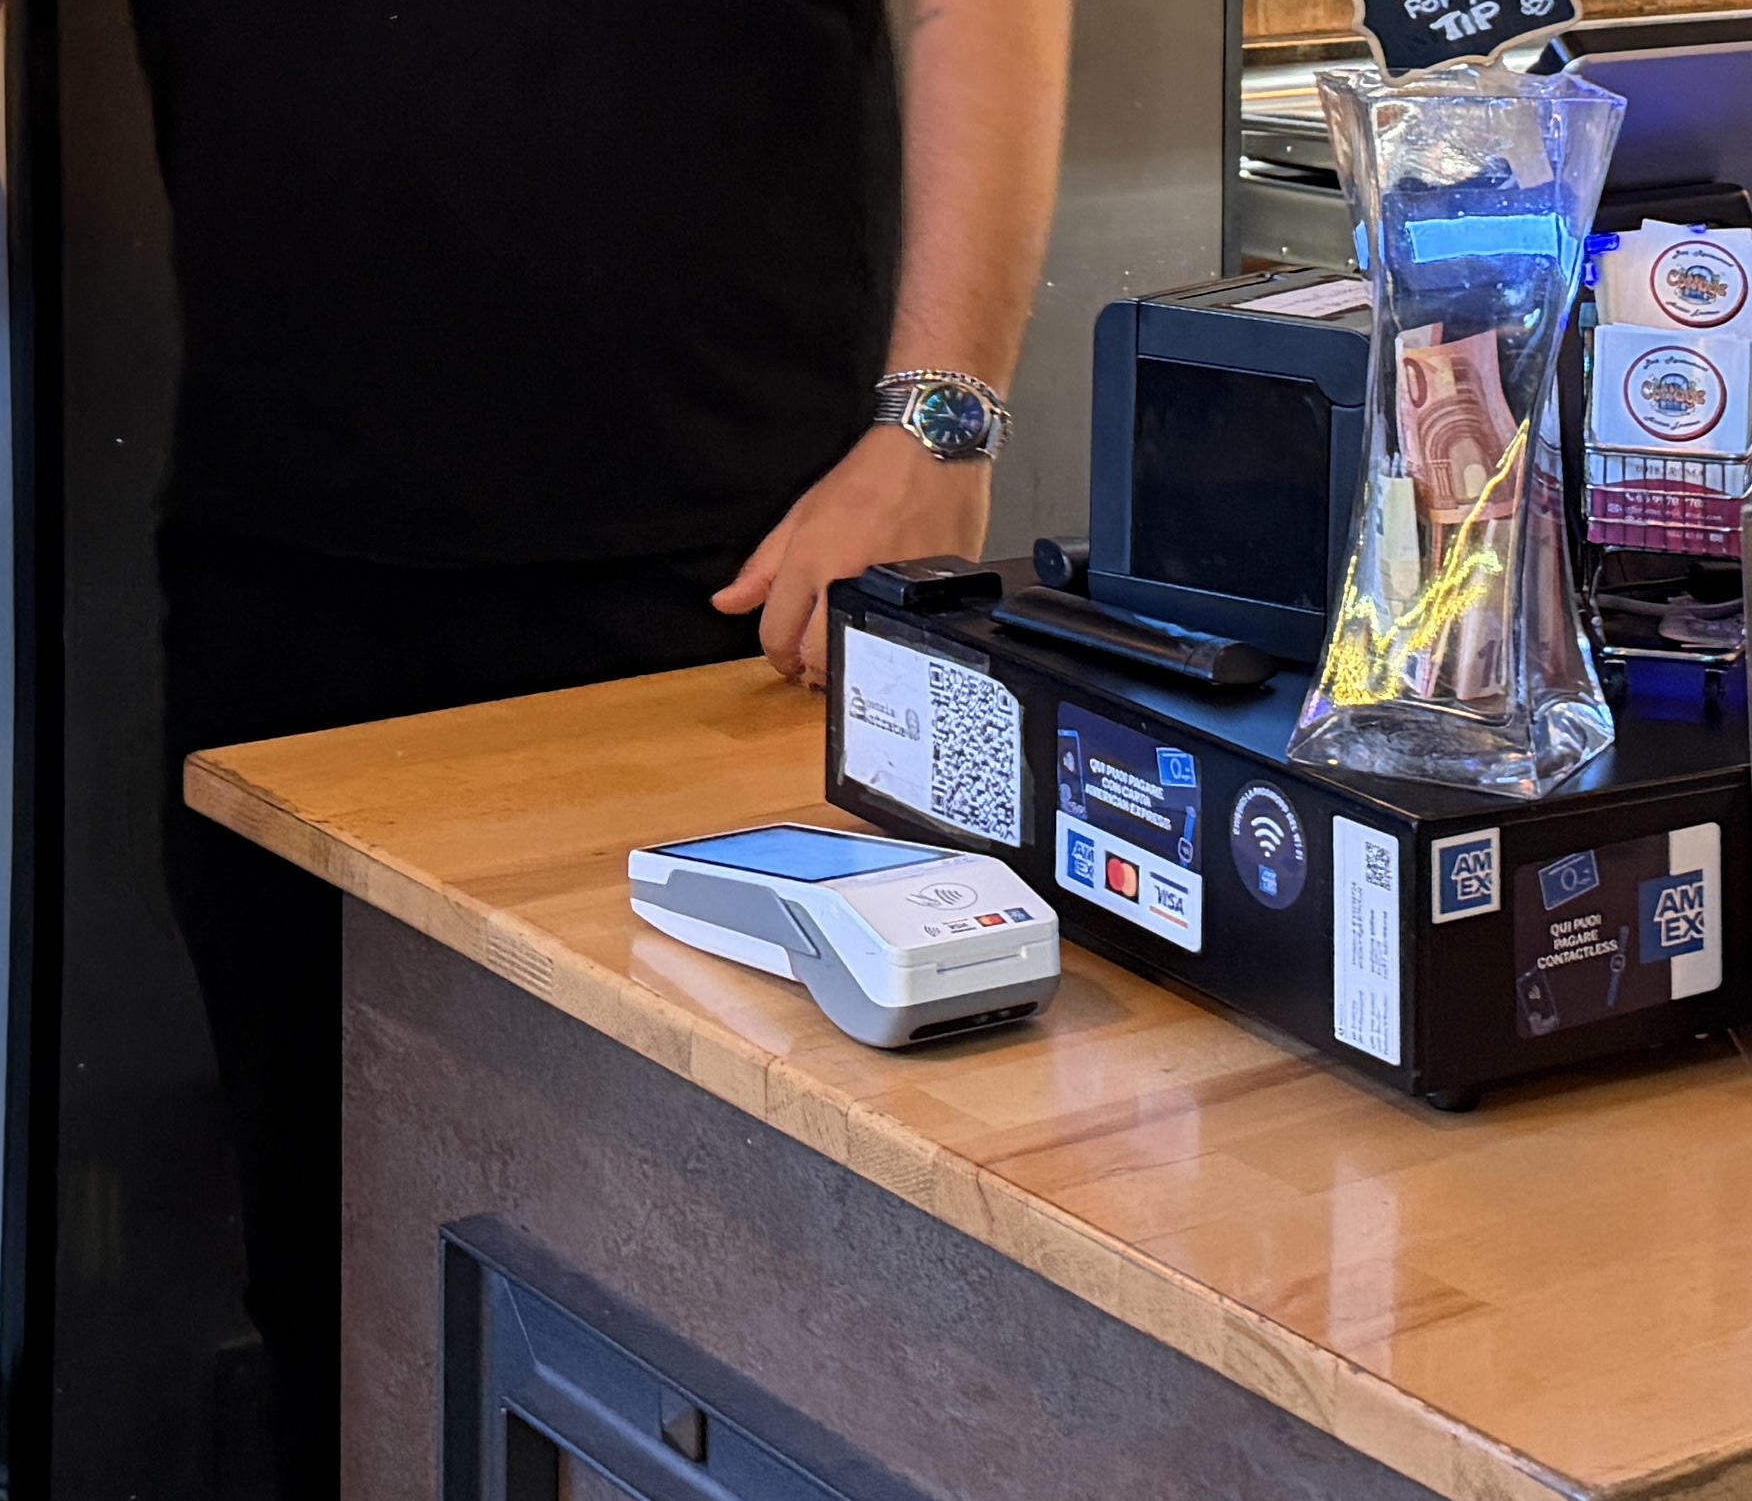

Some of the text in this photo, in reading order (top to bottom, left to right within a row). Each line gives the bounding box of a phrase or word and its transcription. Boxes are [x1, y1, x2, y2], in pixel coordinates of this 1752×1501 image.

[1429, 0, 1501, 41] TIP
[1403, 356, 1428, 409] 0
[1451, 849, 1493, 879] AM
[1153, 885, 1185, 916] VISA
[1457, 875, 1493, 900] EX
[1654, 882, 1704, 921] AM
[1550, 914, 1602, 936] QUI PUOI
[1553, 929, 1598, 950] PAGARE
[1661, 910, 1704, 947] EX
[1537, 939, 1619, 970] CONTACTLESS
